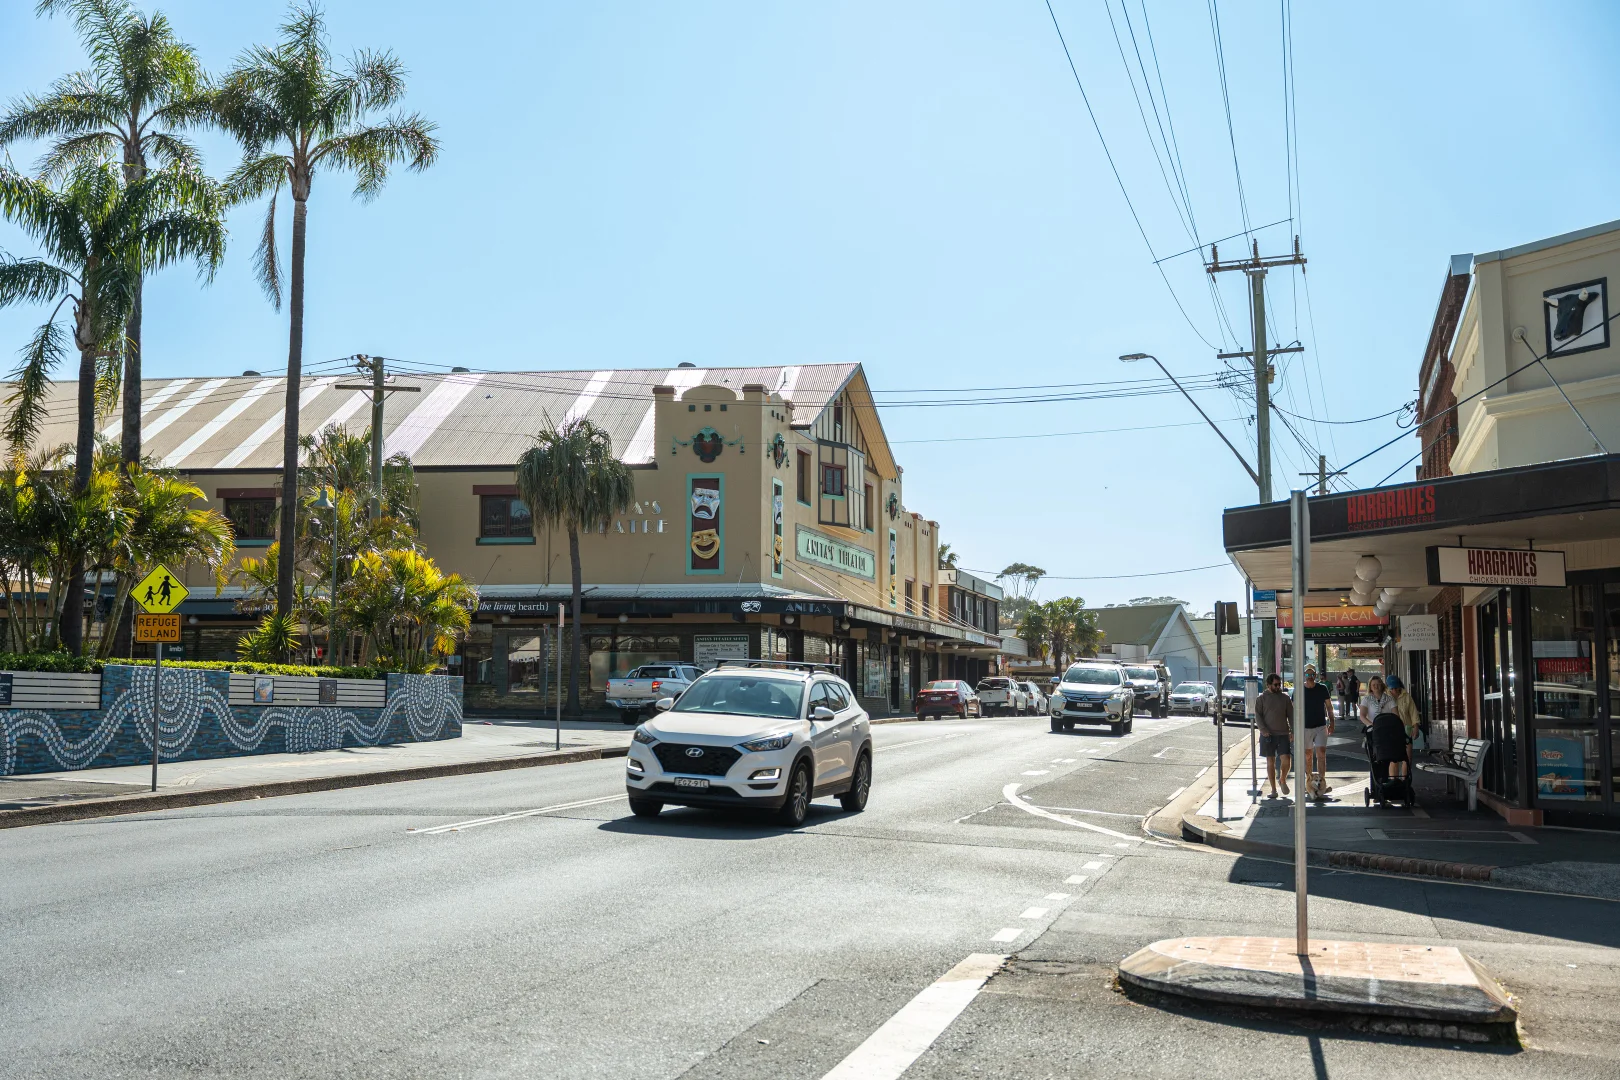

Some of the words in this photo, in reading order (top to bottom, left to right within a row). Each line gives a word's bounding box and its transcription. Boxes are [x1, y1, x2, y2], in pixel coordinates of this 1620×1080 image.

[1347, 486, 1436, 523] HARGRAVES
[1348, 520, 1385, 532] CHICKEN
[1387, 514, 1436, 527] ROTISSERIE
[807, 538, 835, 562] ANITA'S
[1467, 549, 1538, 578] HARGRAVES
[1469, 576, 1499, 584] CHICKEN
[1501, 577, 1538, 585] ROTISSERIE
[493, 602, 516, 612] living
[785, 602, 832, 614] ANITA'S
[138, 617, 177, 627] REFUGE
[1303, 611, 1337, 622] ELISH
[1340, 610, 1371, 621] ACAI
[139, 629, 177, 638] ISLAND
